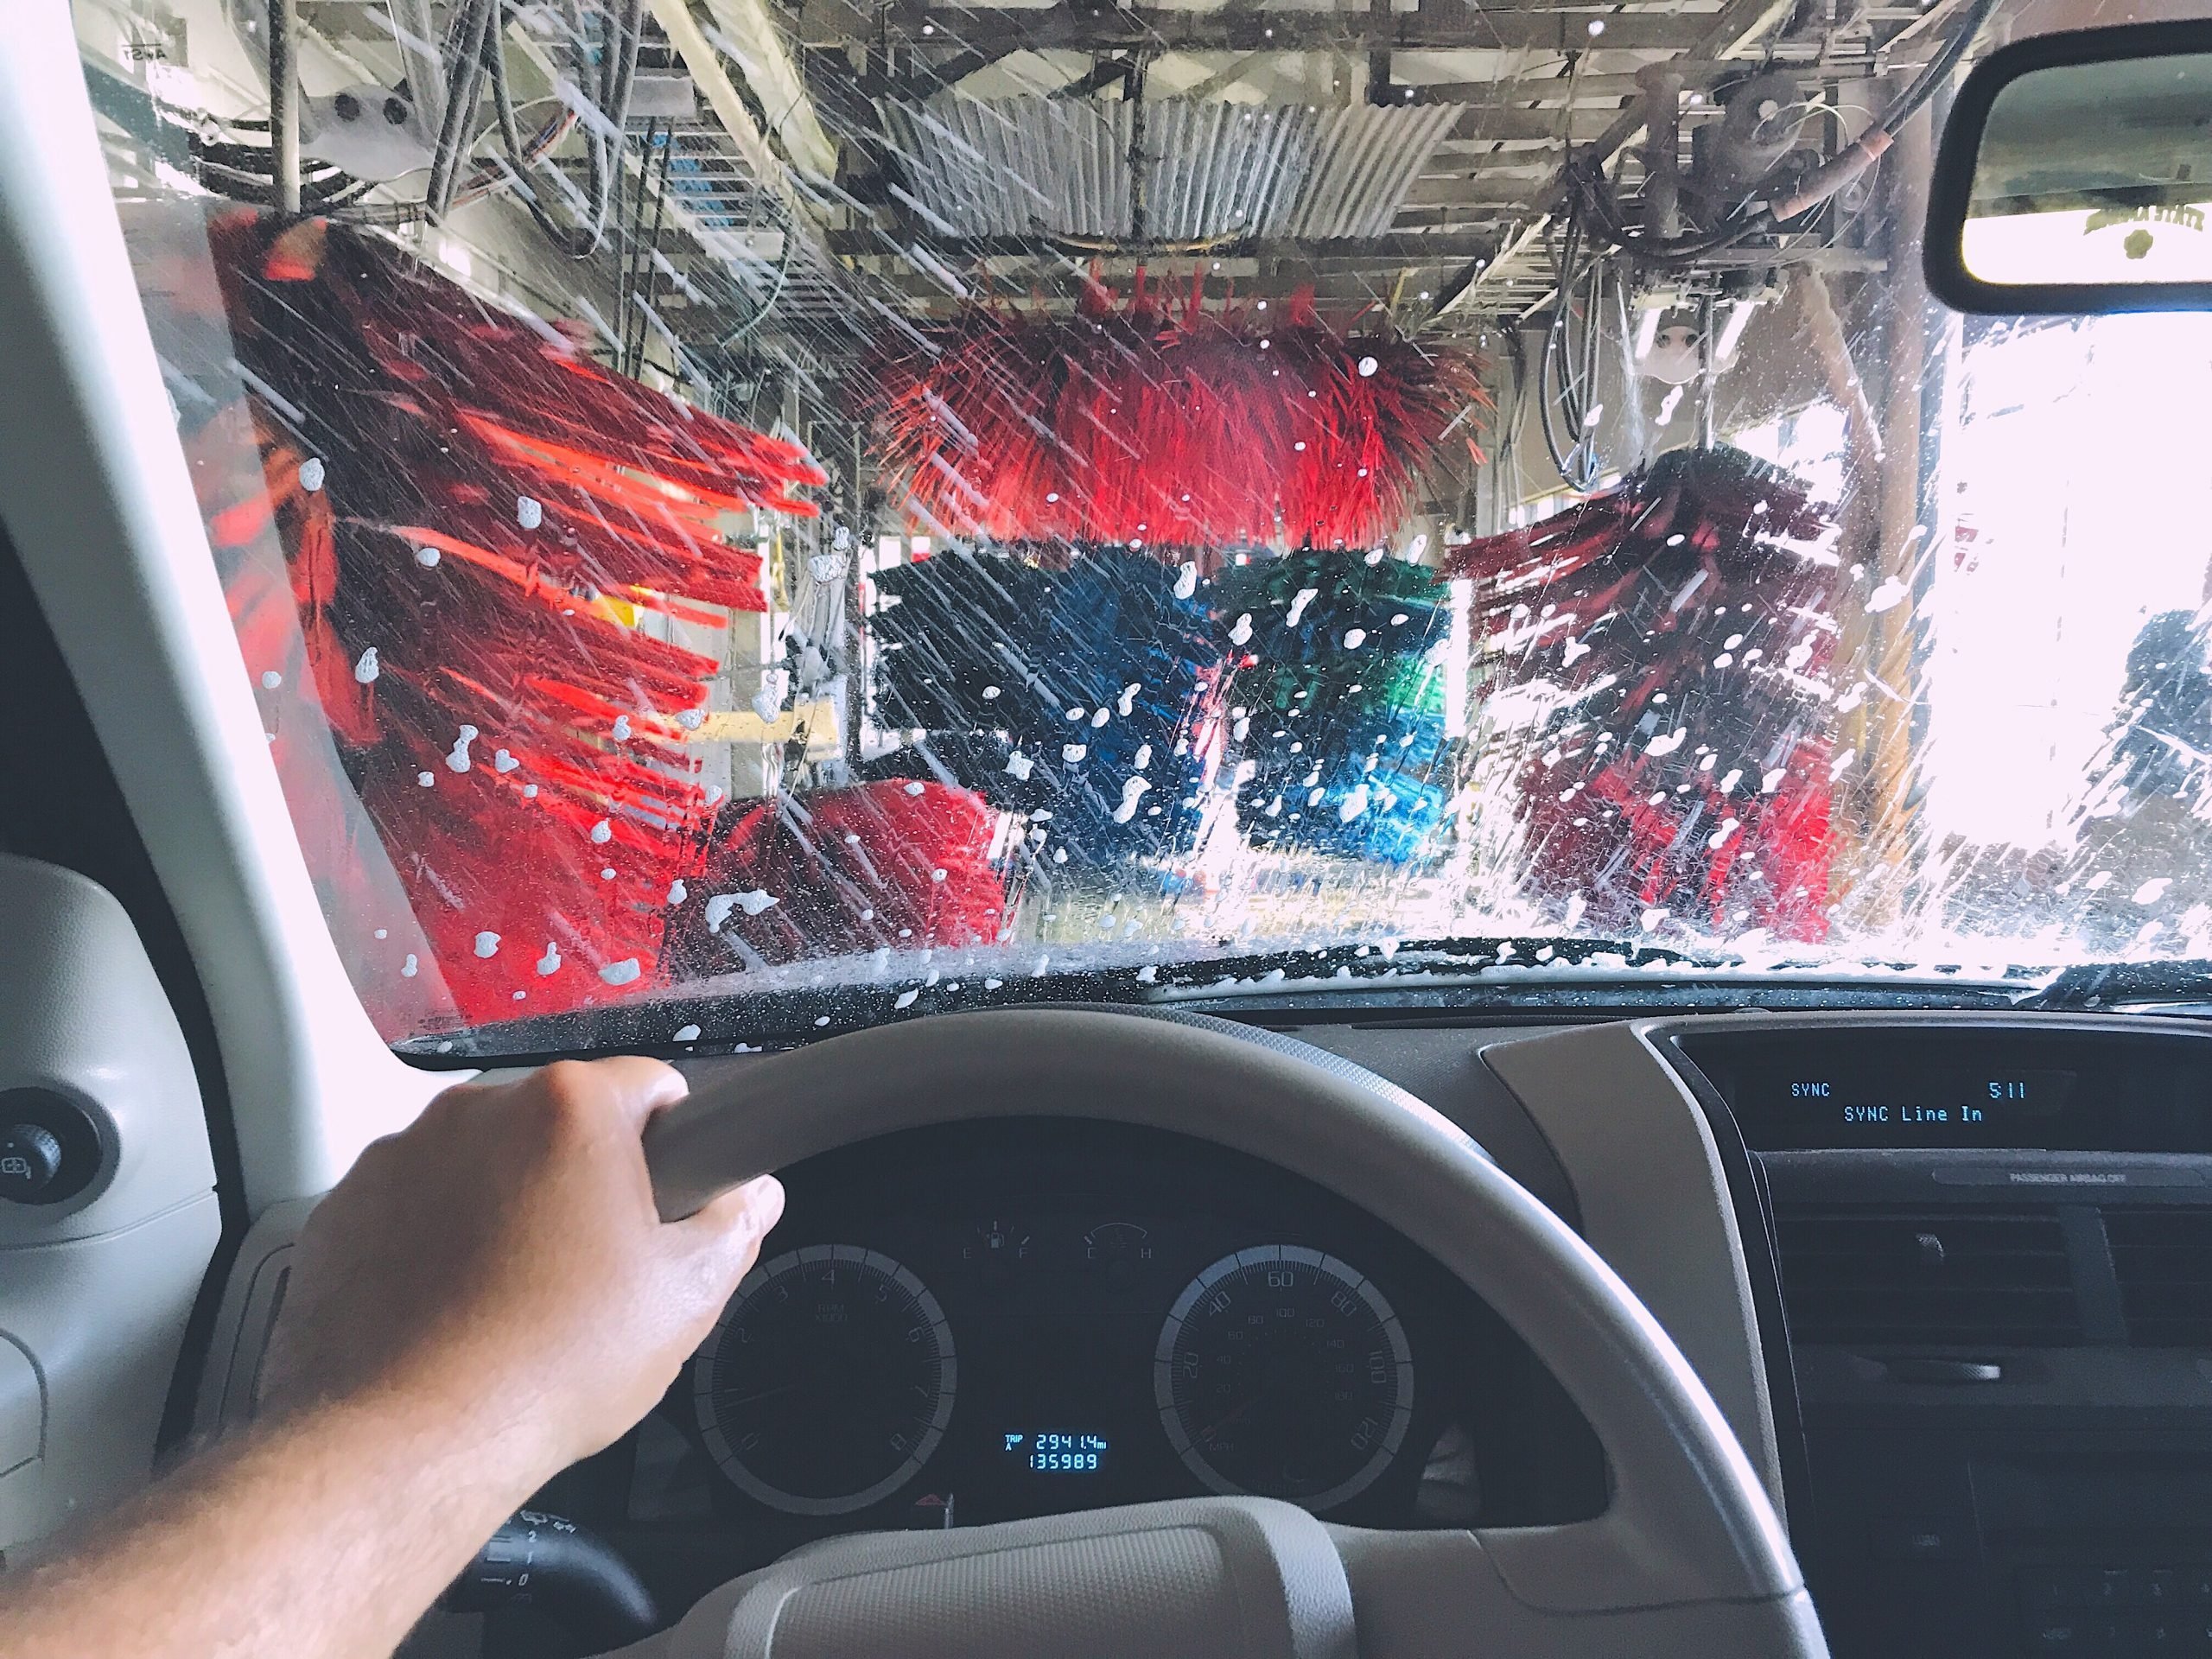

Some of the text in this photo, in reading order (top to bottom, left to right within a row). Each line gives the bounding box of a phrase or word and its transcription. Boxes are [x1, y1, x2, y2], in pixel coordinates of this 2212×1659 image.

[1790, 1083, 1830, 1096] SYNC
[1844, 1106, 1982, 1122] SYNC Line In
[1141, 1247, 1152, 1259] H
[820, 1268, 836, 1285] 4
[1268, 1271, 1294, 1287] 60
[1209, 1291, 1231, 1317] 40
[1331, 1292, 1357, 1317] 80
[1183, 1352, 1198, 1379] 20
[1369, 1350, 1387, 1383] 100
[1005, 1434, 1023, 1443] TRIP
[1351, 1417, 1378, 1450] 120
[1030, 1454, 1097, 1469] 135989
[528, 1530, 537, 1542] 2
[518, 1573, 529, 1586] 0
